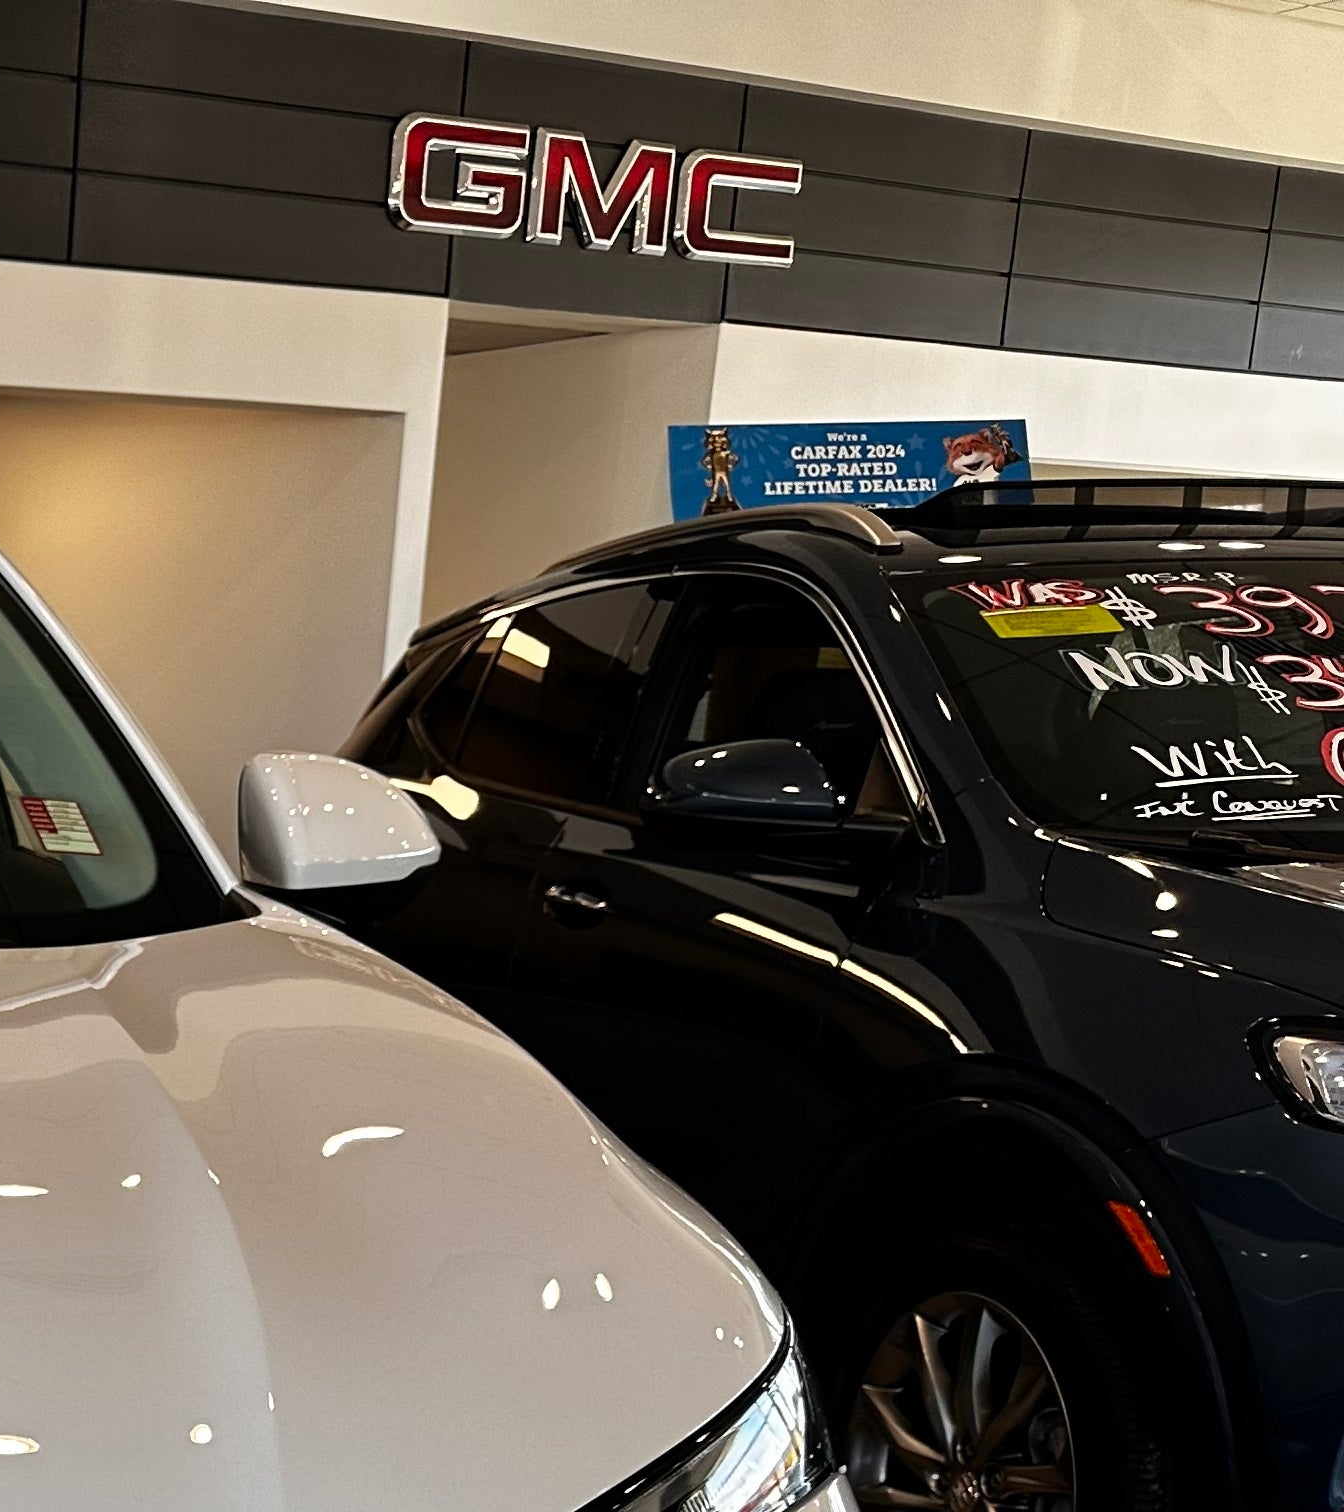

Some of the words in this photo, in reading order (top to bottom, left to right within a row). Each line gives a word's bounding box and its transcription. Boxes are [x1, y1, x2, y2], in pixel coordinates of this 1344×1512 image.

[388, 111, 803, 268] GMC
[827, 431, 859, 443] We're
[860, 434, 868, 442] a
[790, 445, 863, 460] CARFAX
[866, 444, 906, 459] 2024
[796, 462, 898, 478] TOP-RATED
[764, 480, 856, 496] LIFETIME
[859, 478, 938, 494] DEALER!
[949, 579, 1106, 611] WAS
[1058, 642, 1248, 691] NOW
